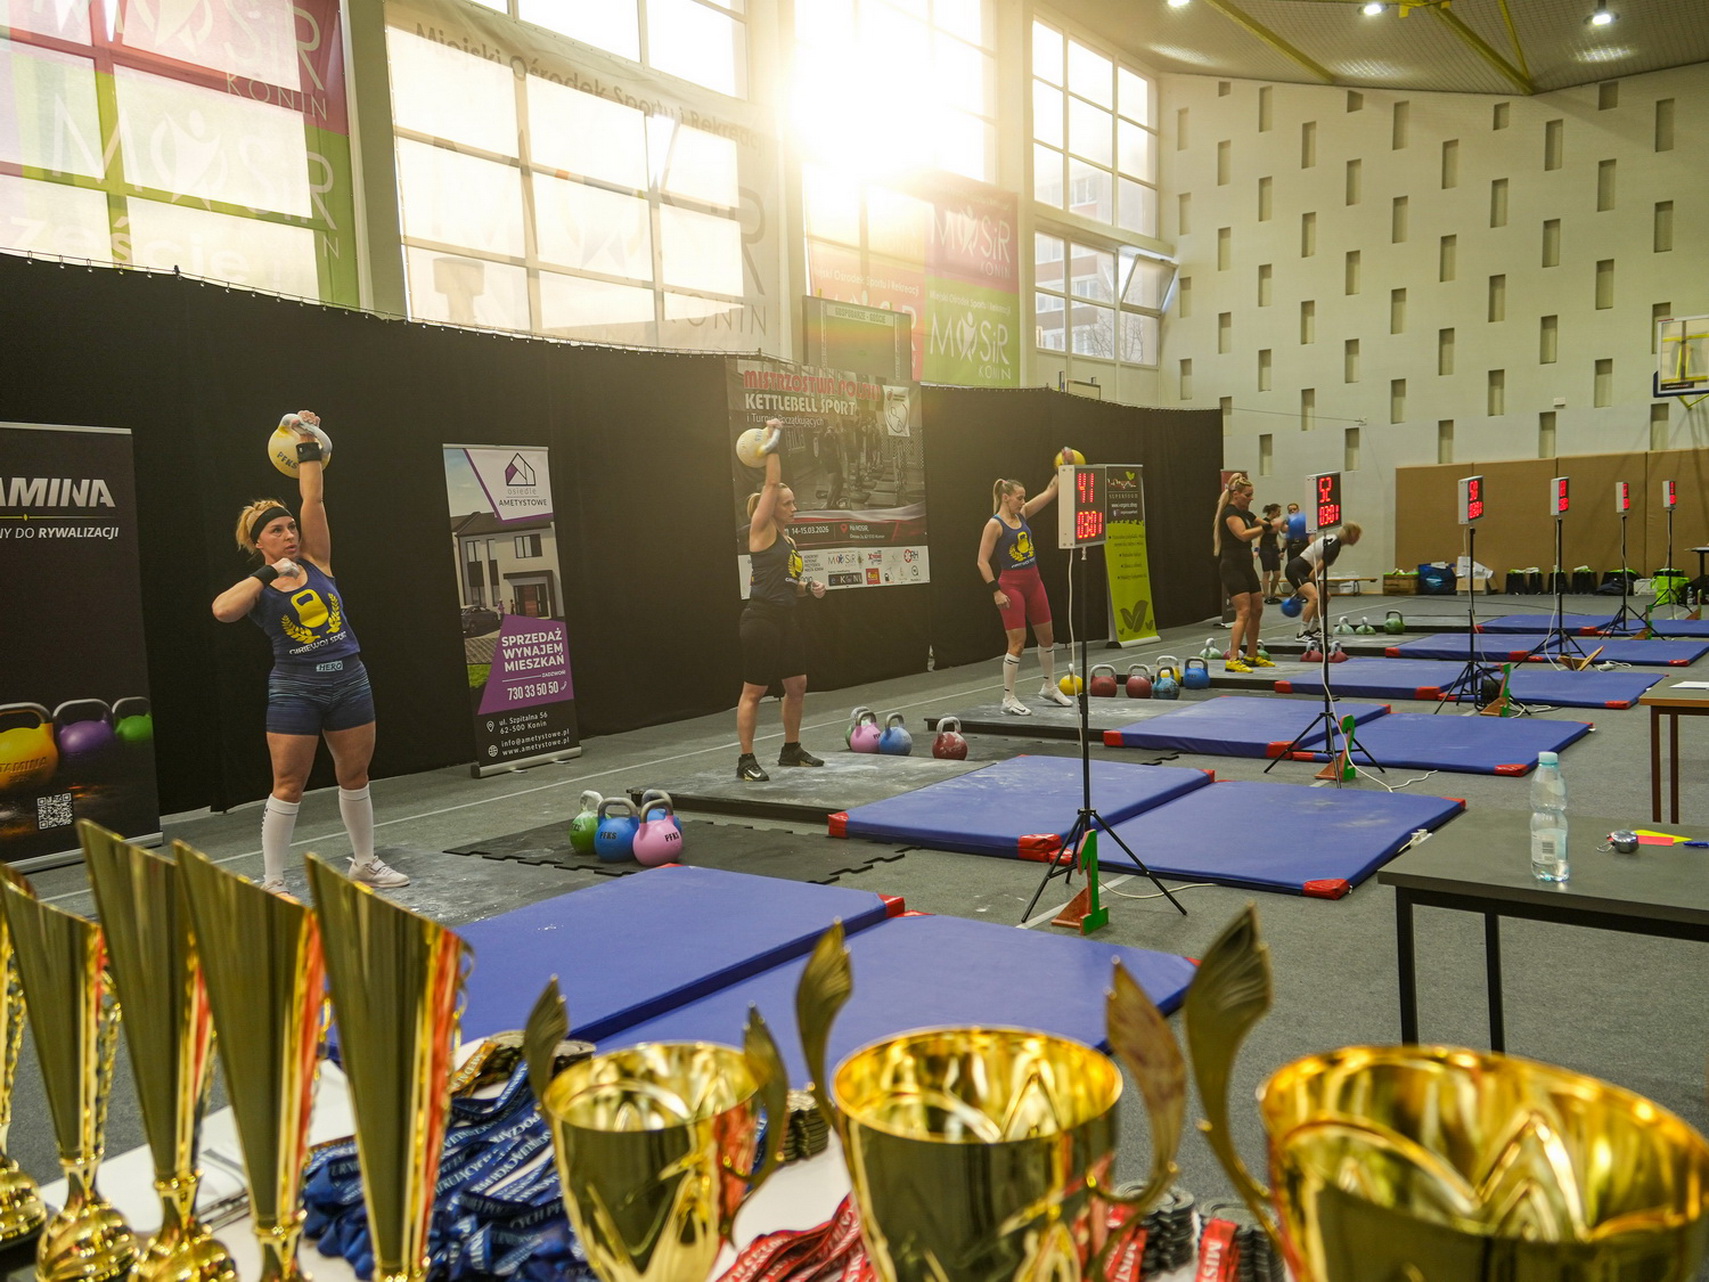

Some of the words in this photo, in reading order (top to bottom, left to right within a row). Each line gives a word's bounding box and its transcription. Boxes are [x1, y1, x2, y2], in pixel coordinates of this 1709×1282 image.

[226, 71, 327, 121] KONIN
[929, 311, 1010, 366] MOSiR
[977, 365, 1011, 380] KONIN
[744, 370, 836, 396] MISTRZOSTWA
[745, 393, 818, 413] KETTLEBELL
[820, 399, 857, 415] SPORT
[507, 488, 538, 496] osiedle
[1077, 473, 1096, 503] 41
[498, 499, 548, 507] AMETYSTOWE
[15, 528, 34, 539] DO
[38, 527, 119, 540] RYWALIZACJI
[501, 627, 562, 647] SPRZEDAŻ
[503, 643, 564, 660] WYNAJEM
[504, 652, 565, 672] MIESZKAŃ
[507, 687, 524, 701] 730
[525, 685, 536, 698] 33
[537, 683, 548, 696] 50
[549, 681, 560, 694] 50
[499, 718, 507, 726] ul.
[509, 713, 538, 725] Szpitalna
[527, 720, 548, 730] Konin
[501, 729, 570, 748] info@ametystowe.pl
[502, 737, 570, 757] www.ametystowe.pl
[1202, 1239, 1222, 1282] MIS
